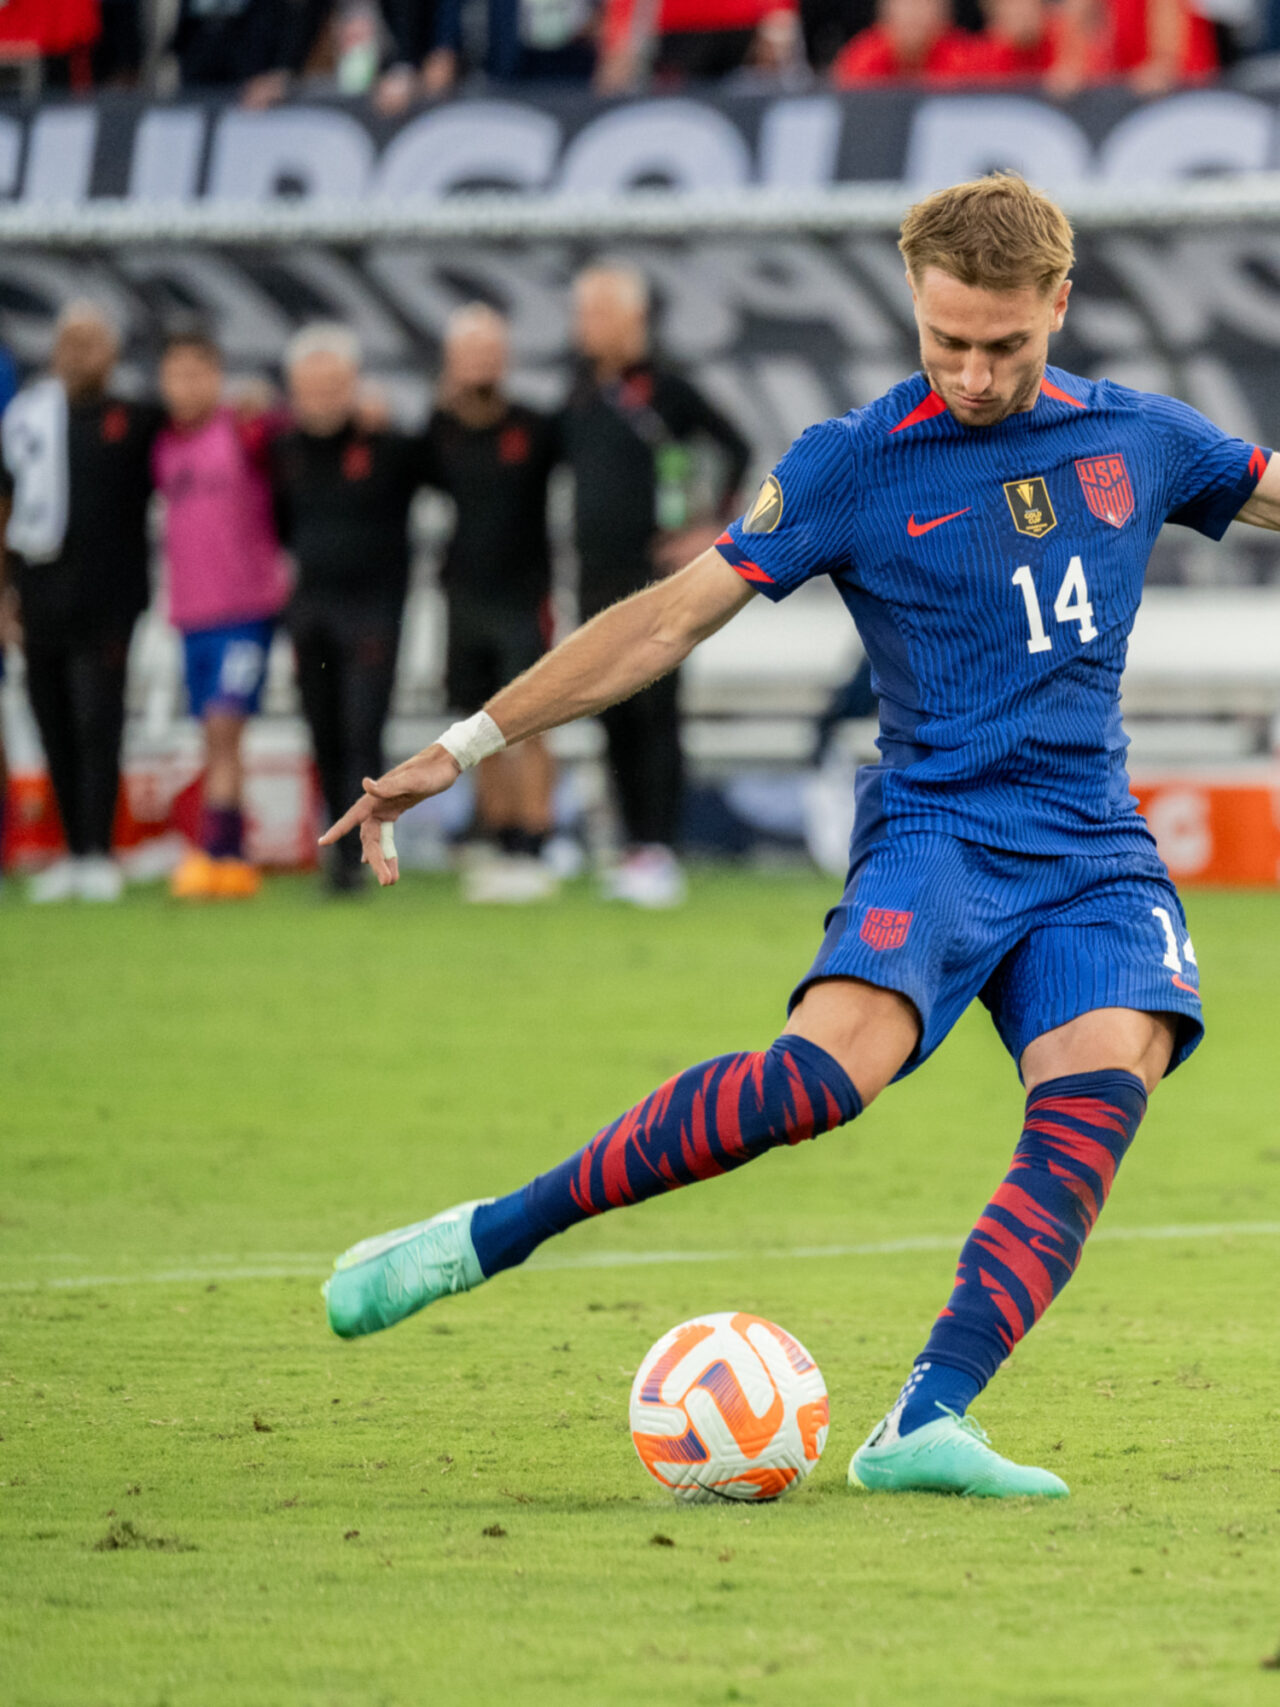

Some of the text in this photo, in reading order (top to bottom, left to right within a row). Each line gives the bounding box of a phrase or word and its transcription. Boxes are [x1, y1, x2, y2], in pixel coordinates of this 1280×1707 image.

[1080, 458, 1123, 488] USA
[1012, 556, 1098, 654] 14
[870, 911, 908, 927] USA
